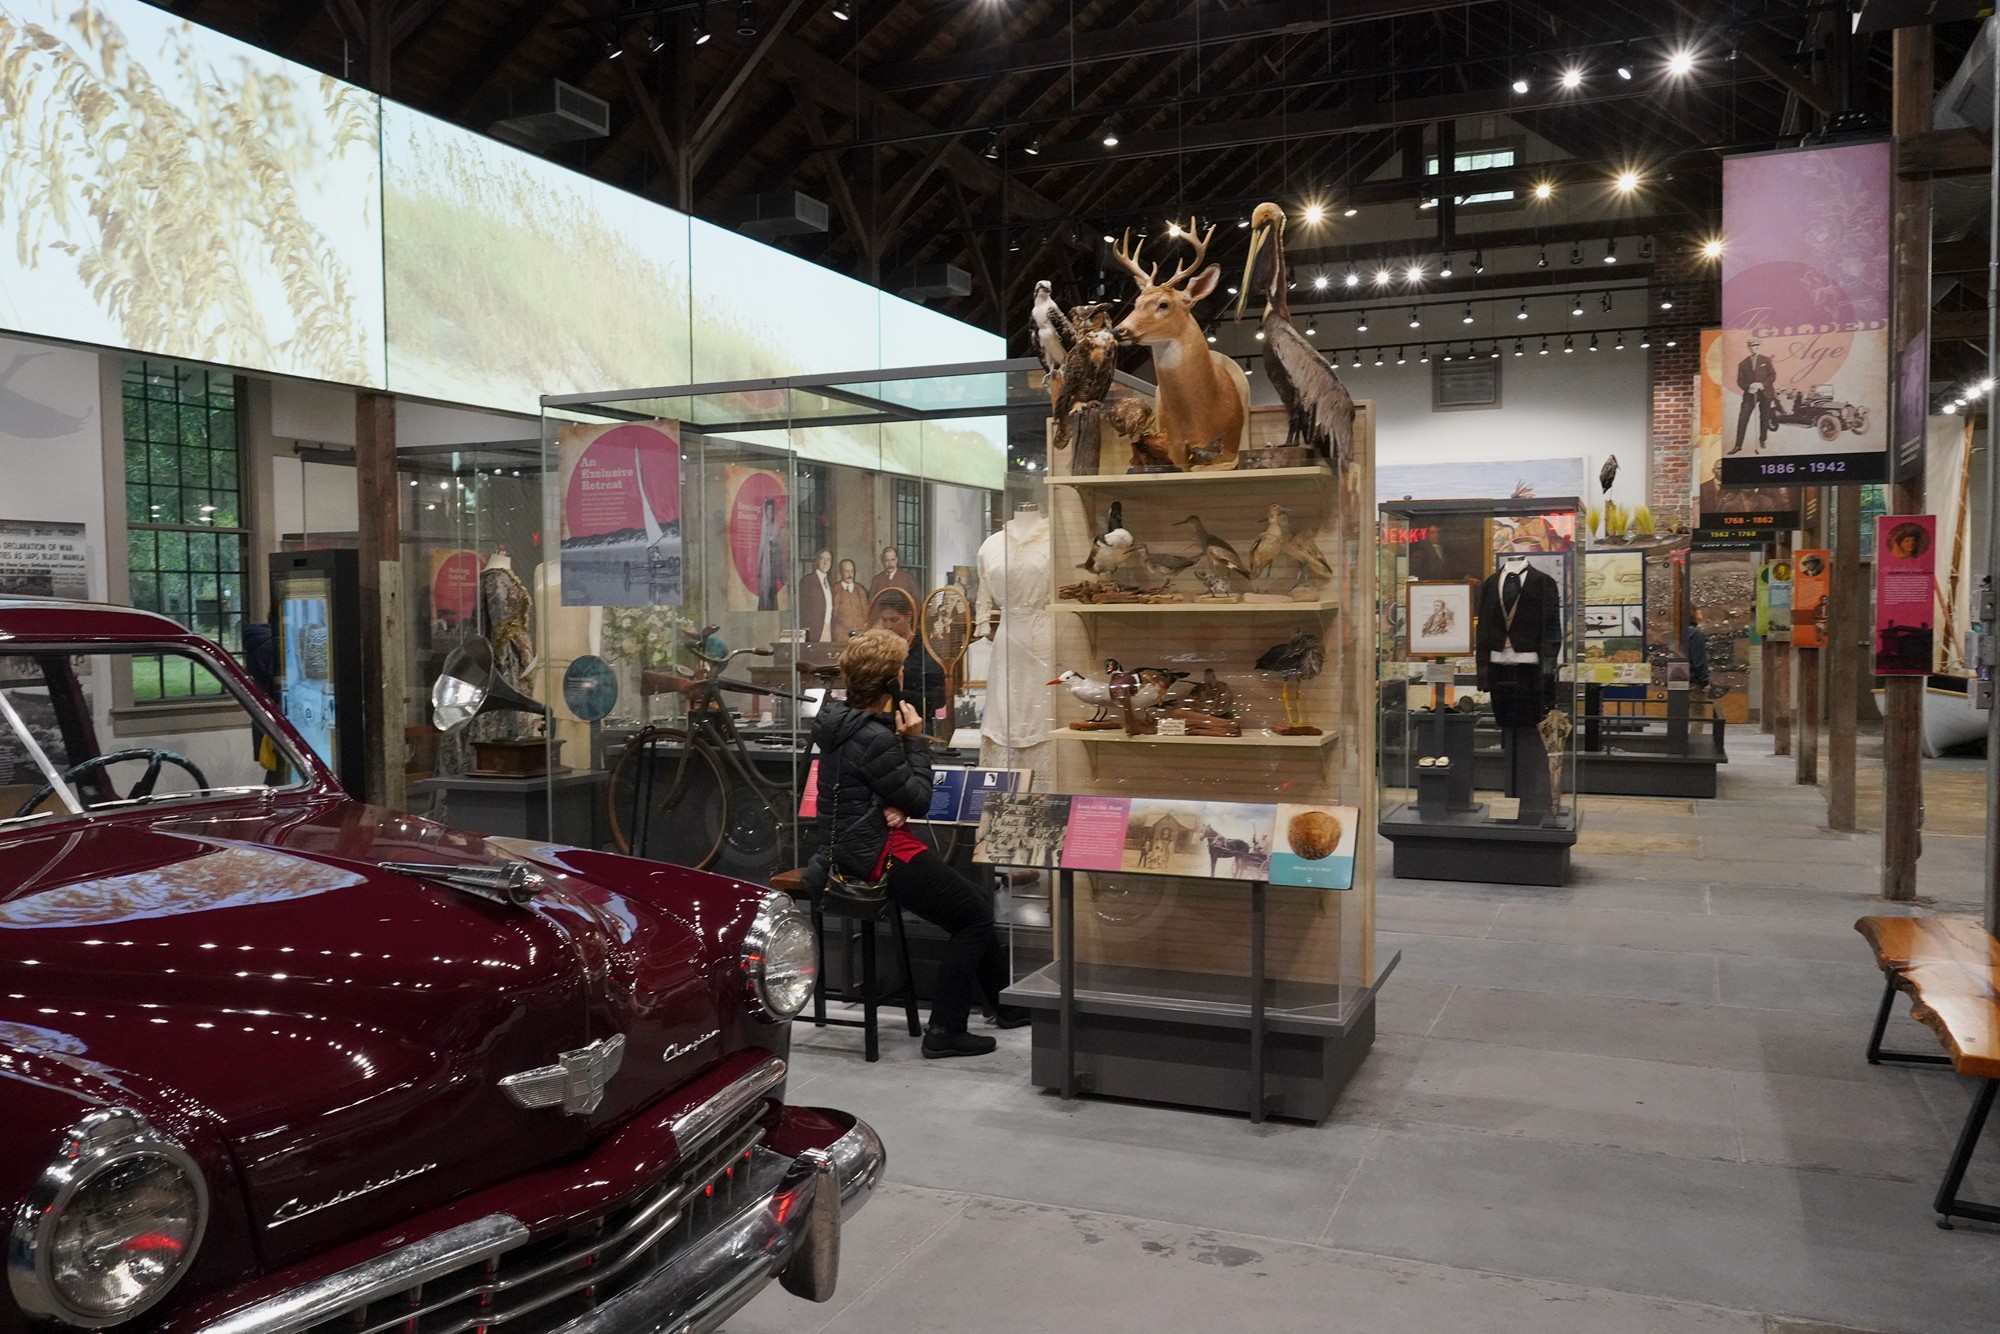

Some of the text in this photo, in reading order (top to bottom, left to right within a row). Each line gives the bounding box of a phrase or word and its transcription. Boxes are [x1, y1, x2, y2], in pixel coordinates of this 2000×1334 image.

[1772, 335, 1845, 384] Age
[581, 457, 596, 467] An
[581, 468, 634, 479] Exclusive
[1760, 463, 1795, 475] 1886
[1810, 461, 1846, 473] 1942
[582, 480, 623, 490] Retreat
[1724, 517, 1745, 525] 1768
[1753, 516, 1775, 524] 1862
[267, 1163, 438, 1230] Studebaker
